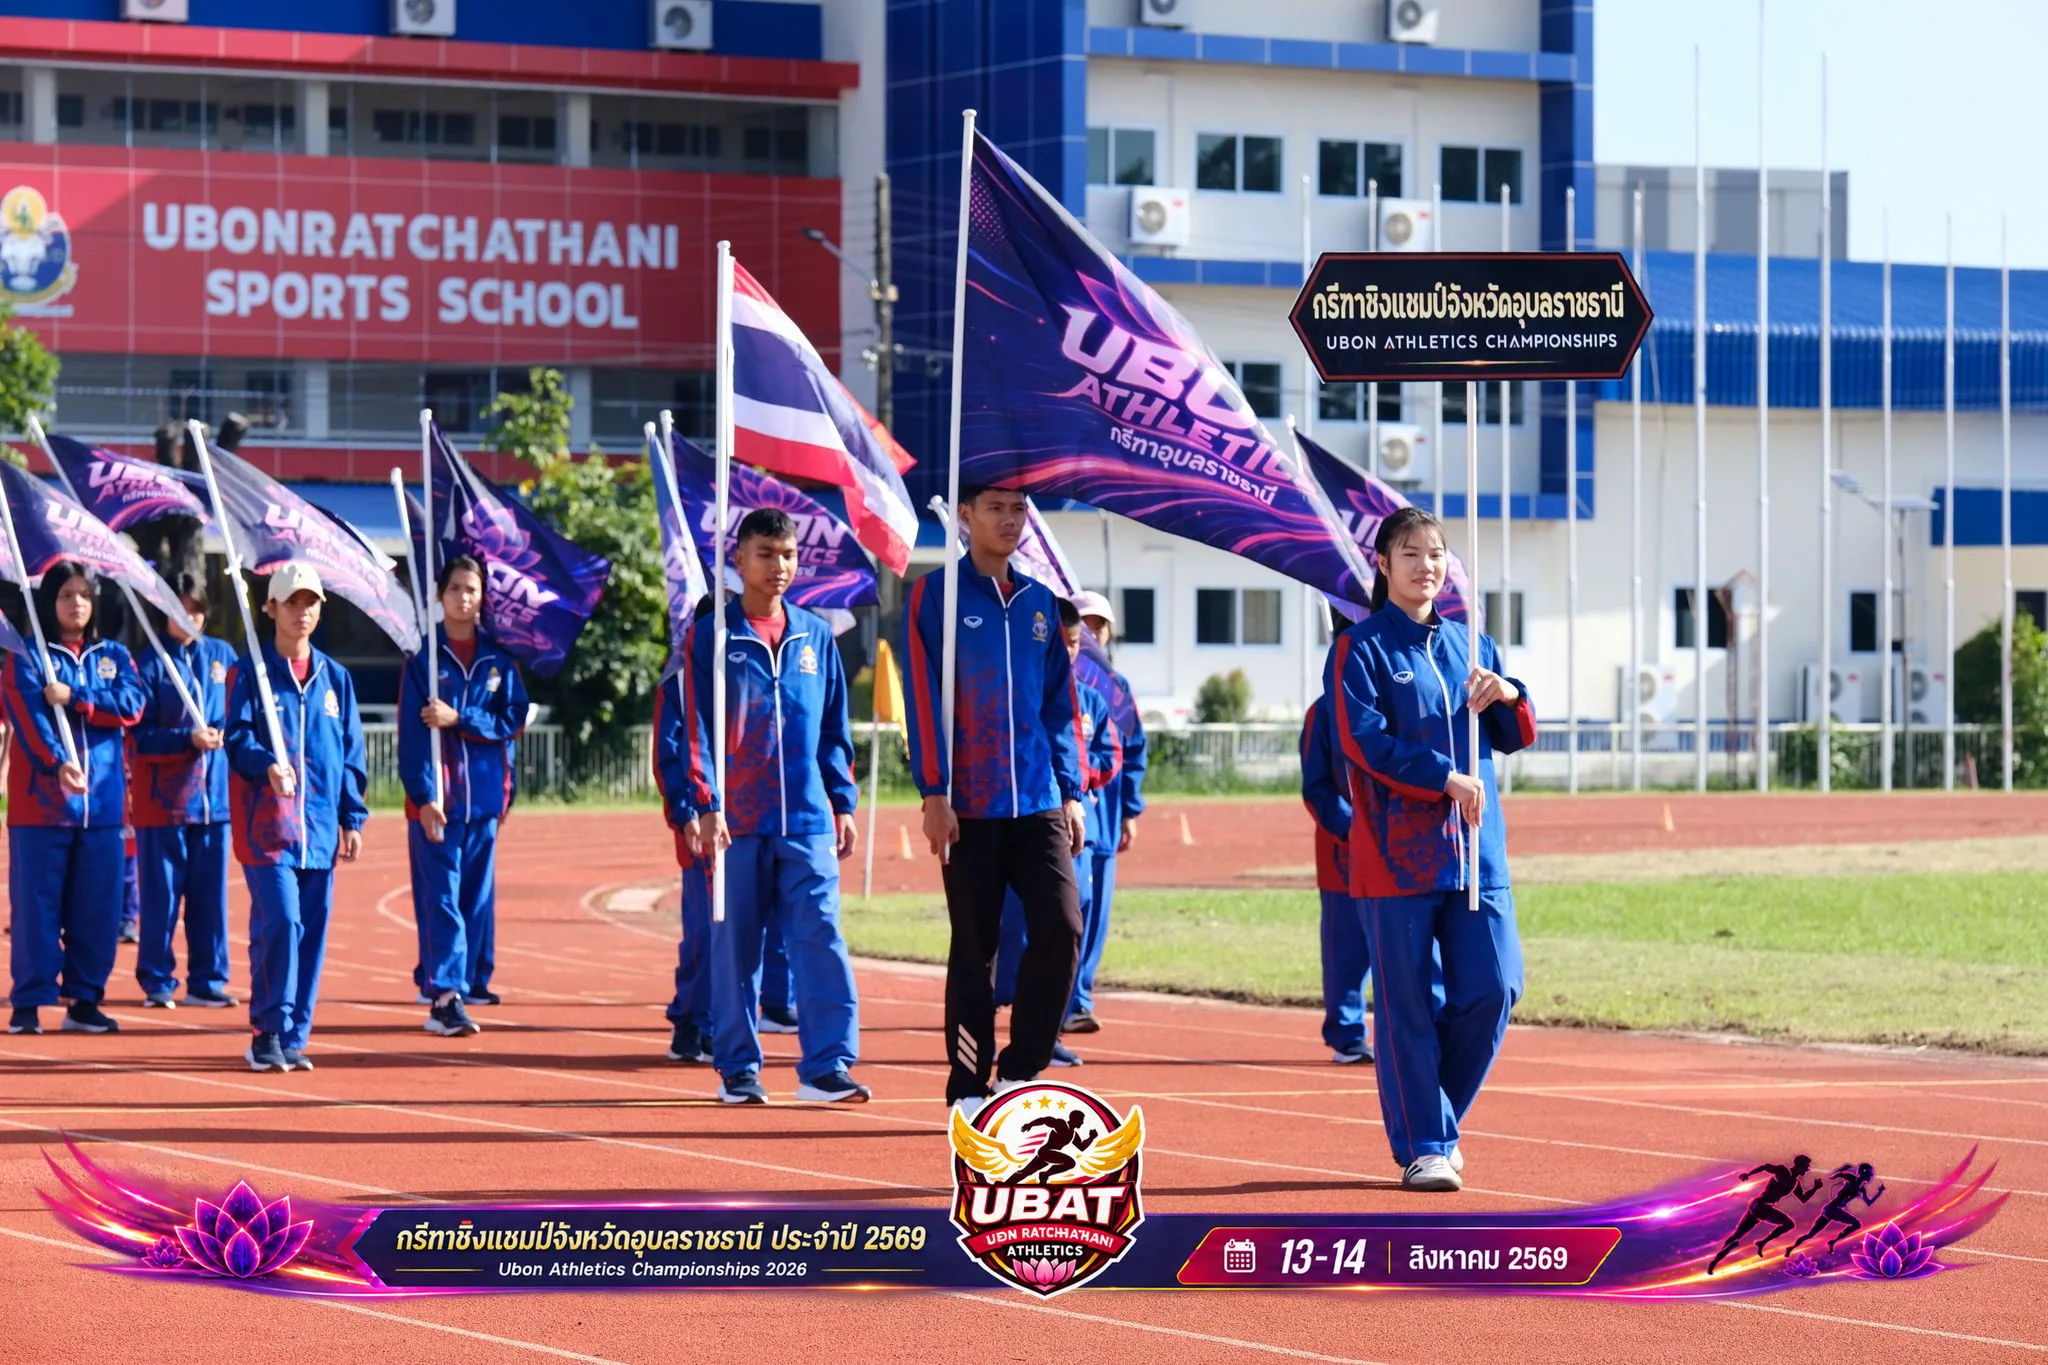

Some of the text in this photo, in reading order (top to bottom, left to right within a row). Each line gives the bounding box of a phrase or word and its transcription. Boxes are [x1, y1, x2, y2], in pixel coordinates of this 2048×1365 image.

[143, 202, 679, 269] UBONRATCHATHANI
[206, 268, 640, 330] SPORTS SCHOOL
[1326, 333, 1618, 350] UBON ATHLETICS CHAMPIONSHIPS
